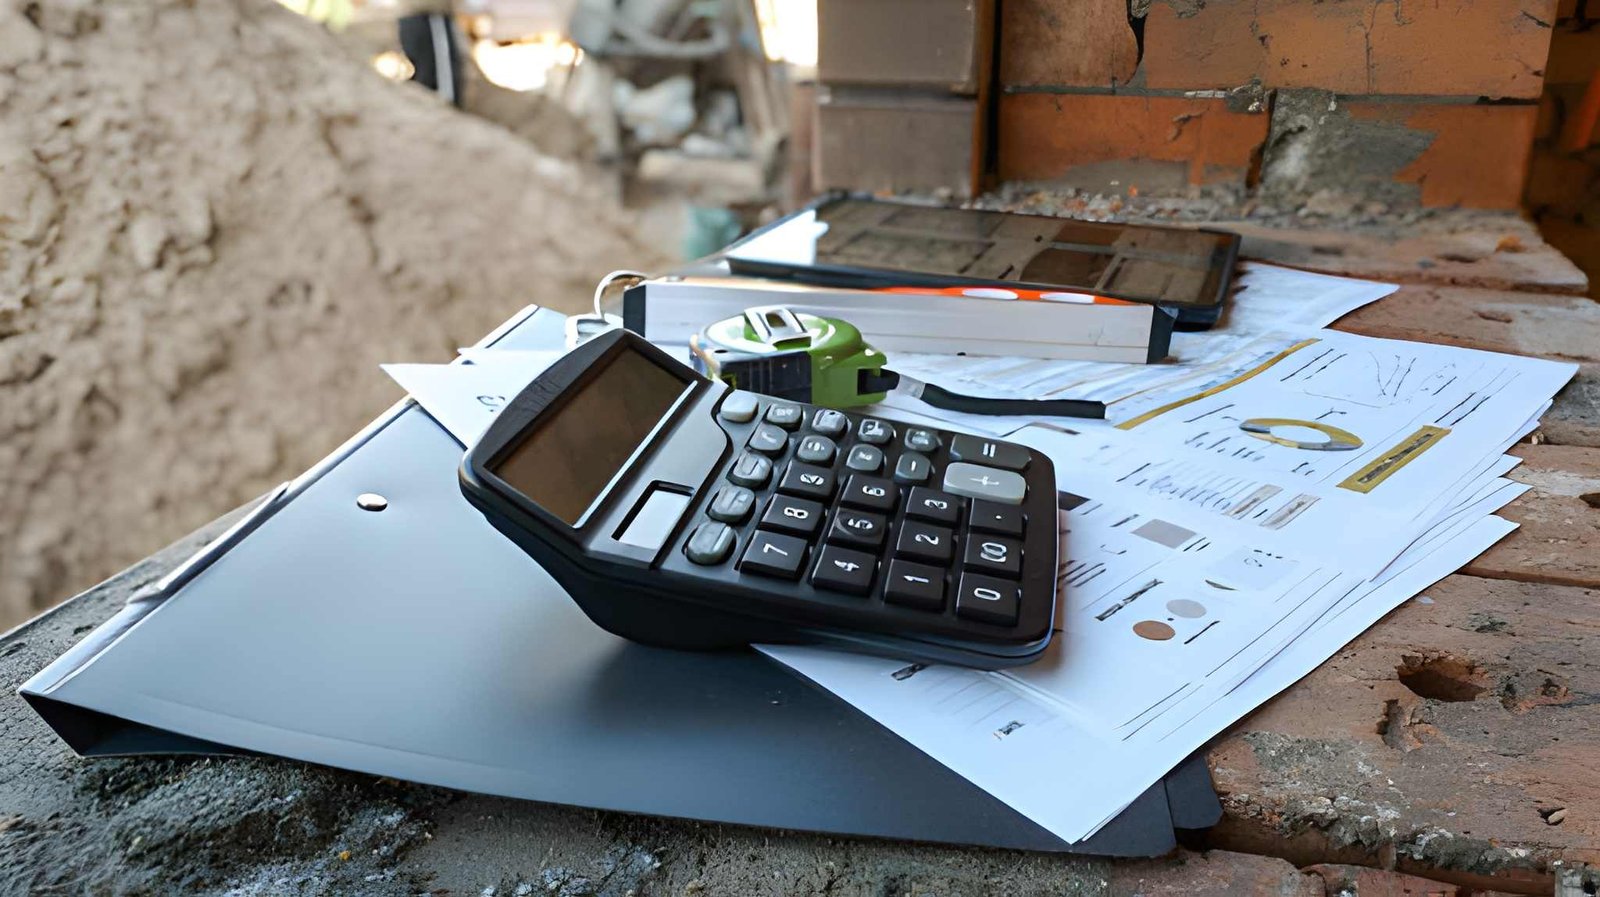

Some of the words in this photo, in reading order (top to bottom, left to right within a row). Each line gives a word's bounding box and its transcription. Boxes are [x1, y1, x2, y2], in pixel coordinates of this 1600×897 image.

[783, 506, 809, 519] 8
[914, 534, 940, 546] 2
[762, 543, 789, 556] 7
[833, 559, 861, 572] 4
[903, 575, 930, 584] 1
[973, 587, 1001, 601] 0
